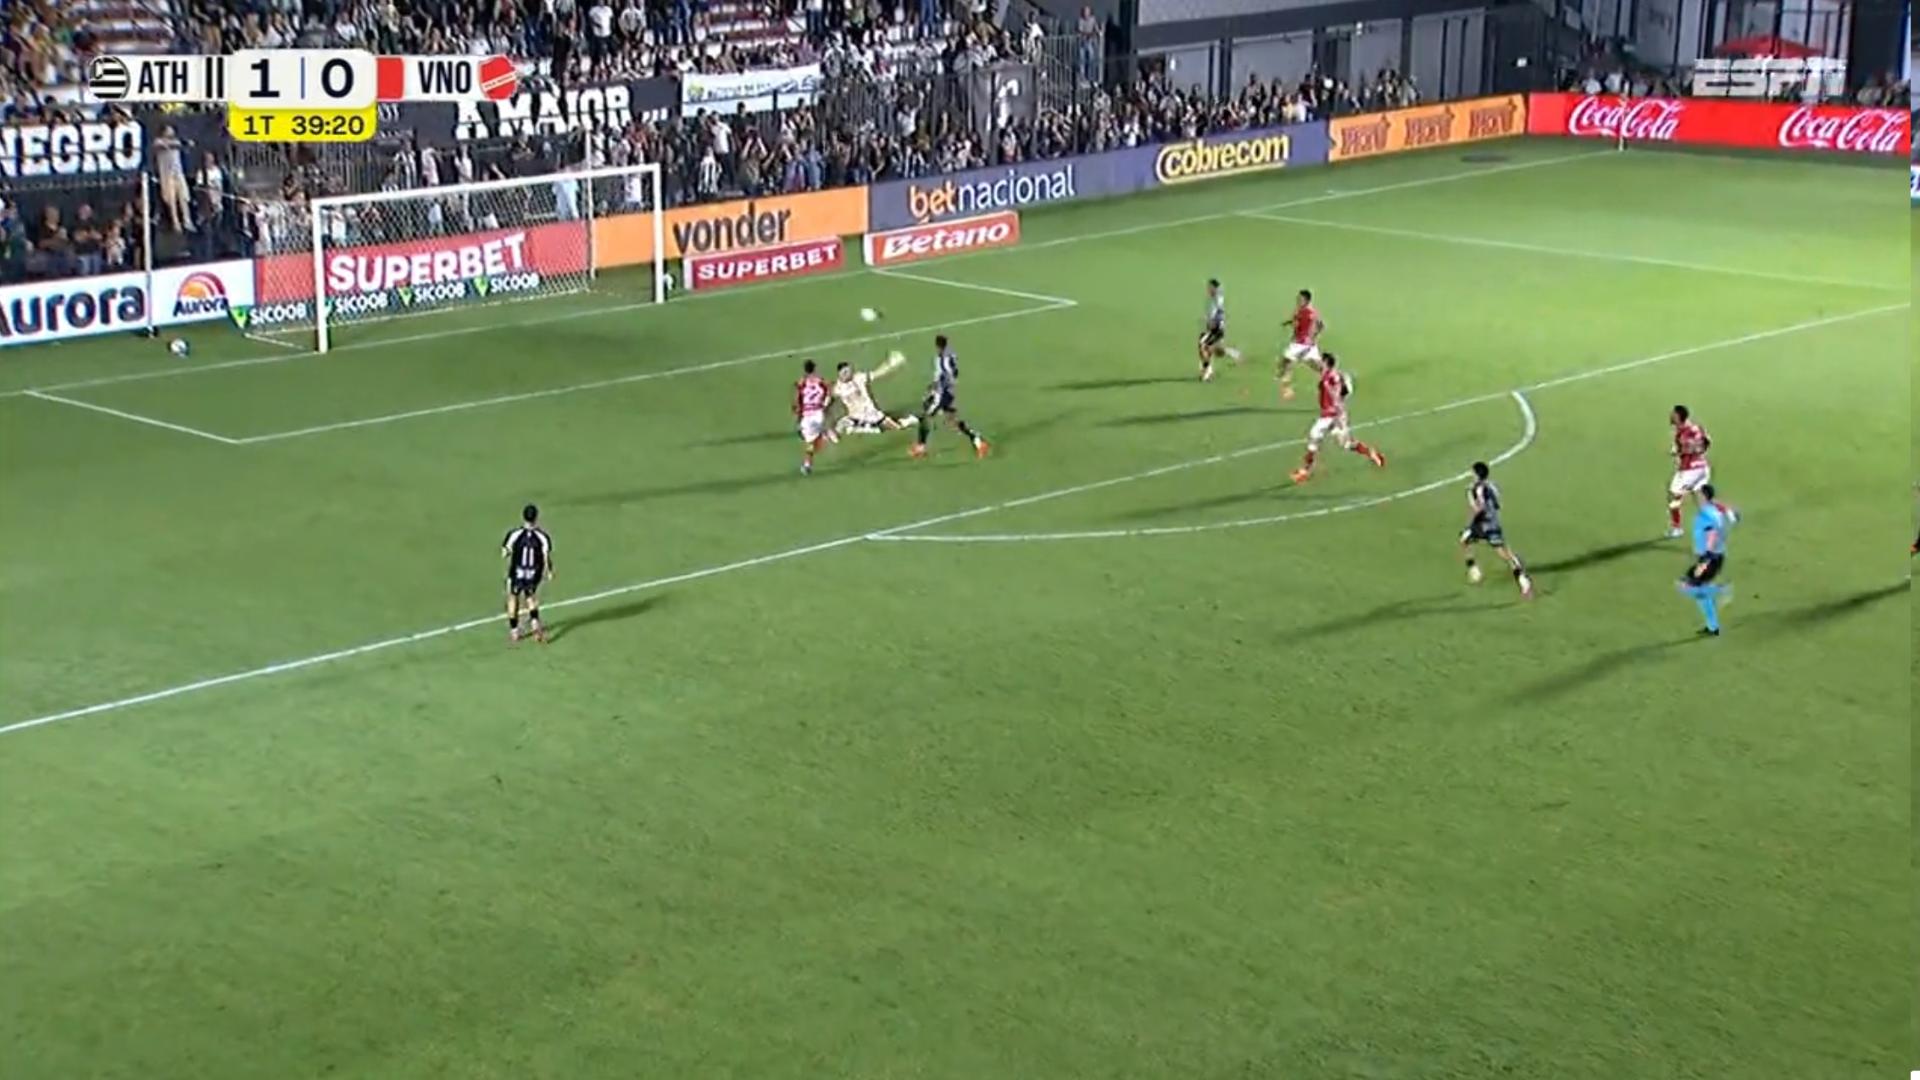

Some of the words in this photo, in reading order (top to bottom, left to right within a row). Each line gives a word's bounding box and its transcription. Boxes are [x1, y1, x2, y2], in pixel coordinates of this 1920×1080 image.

[0, 120, 143, 177] NEGRO
[1163, 133, 1290, 176] cobrecom
[908, 164, 1077, 224] betnacional
[672, 202, 791, 255] vonder
[881, 223, 1011, 259] Betano
[327, 233, 525, 291] SUPERBET
[697, 243, 838, 280] SUPERBET
[415, 282, 466, 302] SICOOB
[490, 273, 540, 293] SICOOB
[173, 297, 228, 317] Aurora
[250, 302, 306, 325] SICOOB
[336, 292, 388, 313] SICOOB
[522, 546, 535, 567] 11
